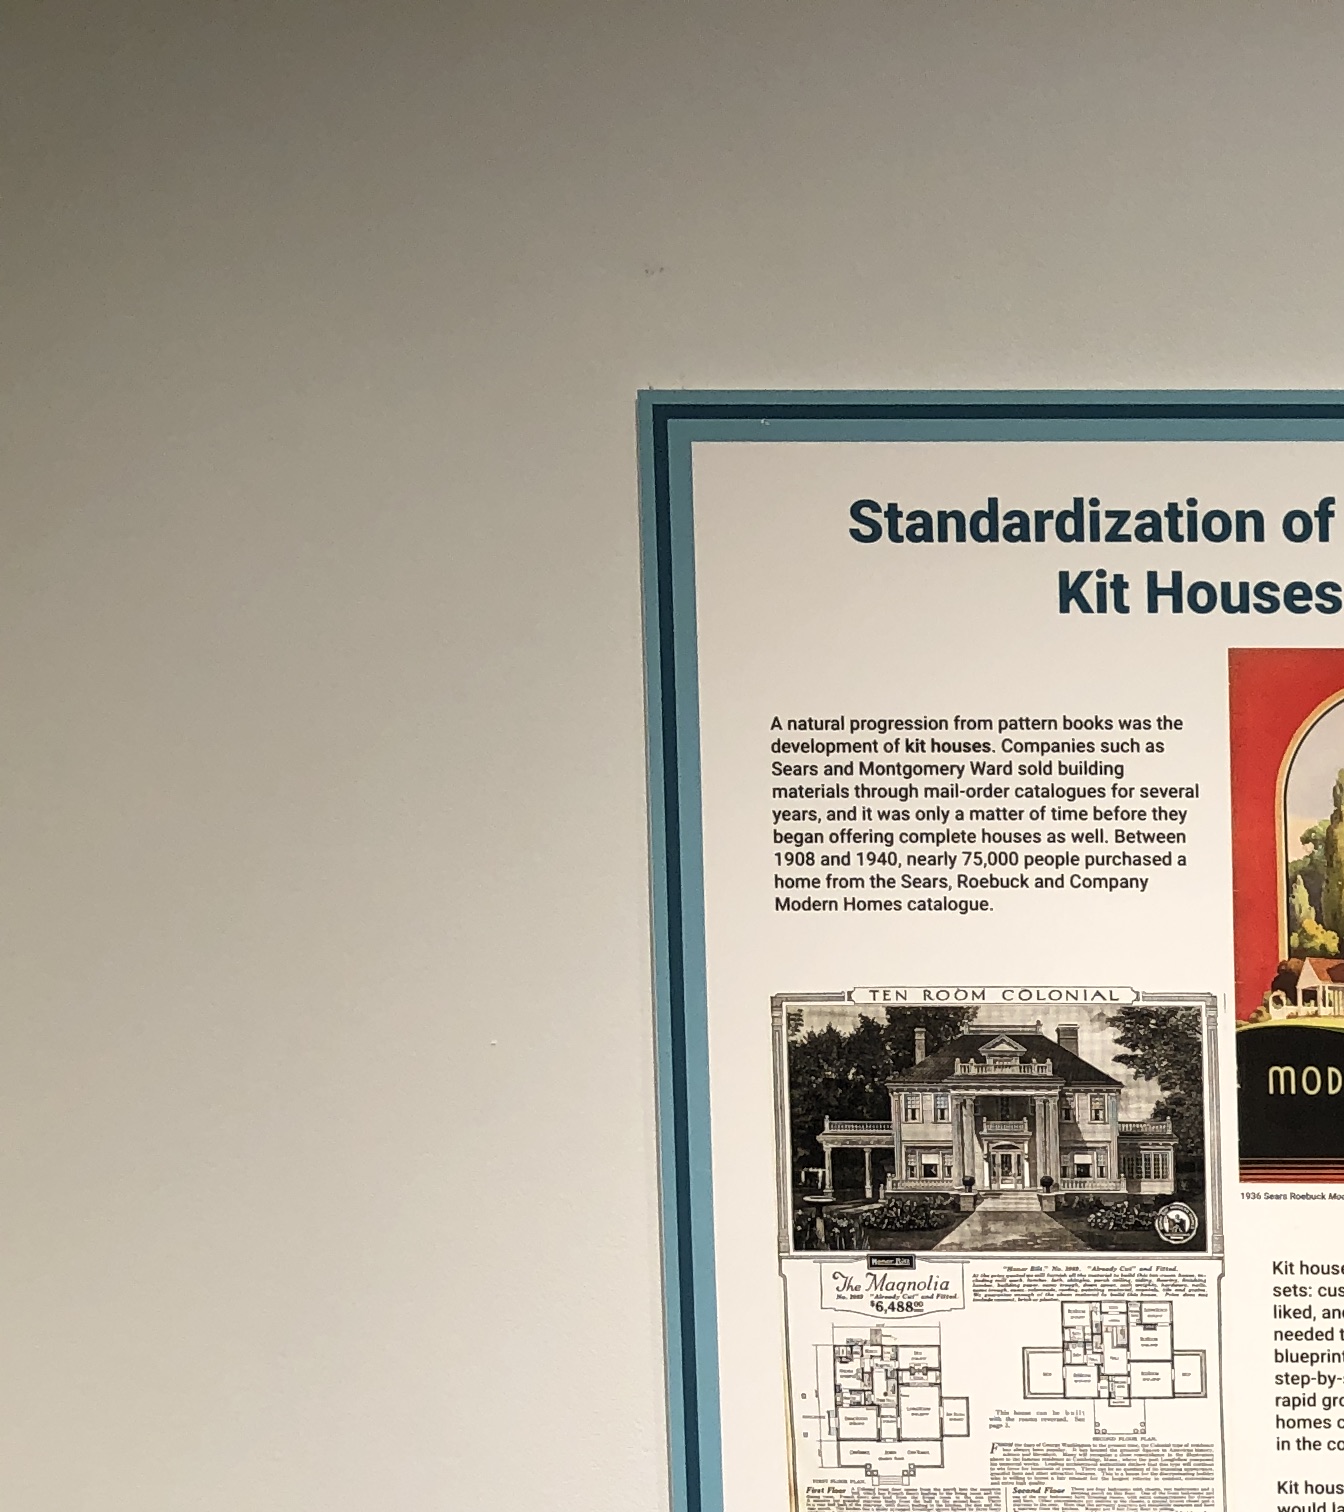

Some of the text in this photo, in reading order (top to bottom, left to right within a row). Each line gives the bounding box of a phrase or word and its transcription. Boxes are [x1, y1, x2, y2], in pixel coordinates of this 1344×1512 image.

[849, 497, 1265, 543] Standardization
[1282, 496, 1336, 543] of
[1058, 568, 1342, 614] Kit Houses
[770, 715, 1183, 734] A natural progression from pattern books was the
[869, 988, 1120, 1001] TEN ROOM COLONIAL
[1241, 1192, 1261, 1200] 1936
[1264, 1192, 1288, 1200] Sears
[1290, 1192, 1326, 1200] Roebuck
[1273, 1261, 1295, 1275] Kit
[832, 1271, 861, 1292] The
[865, 1272, 950, 1294] Magnolia
